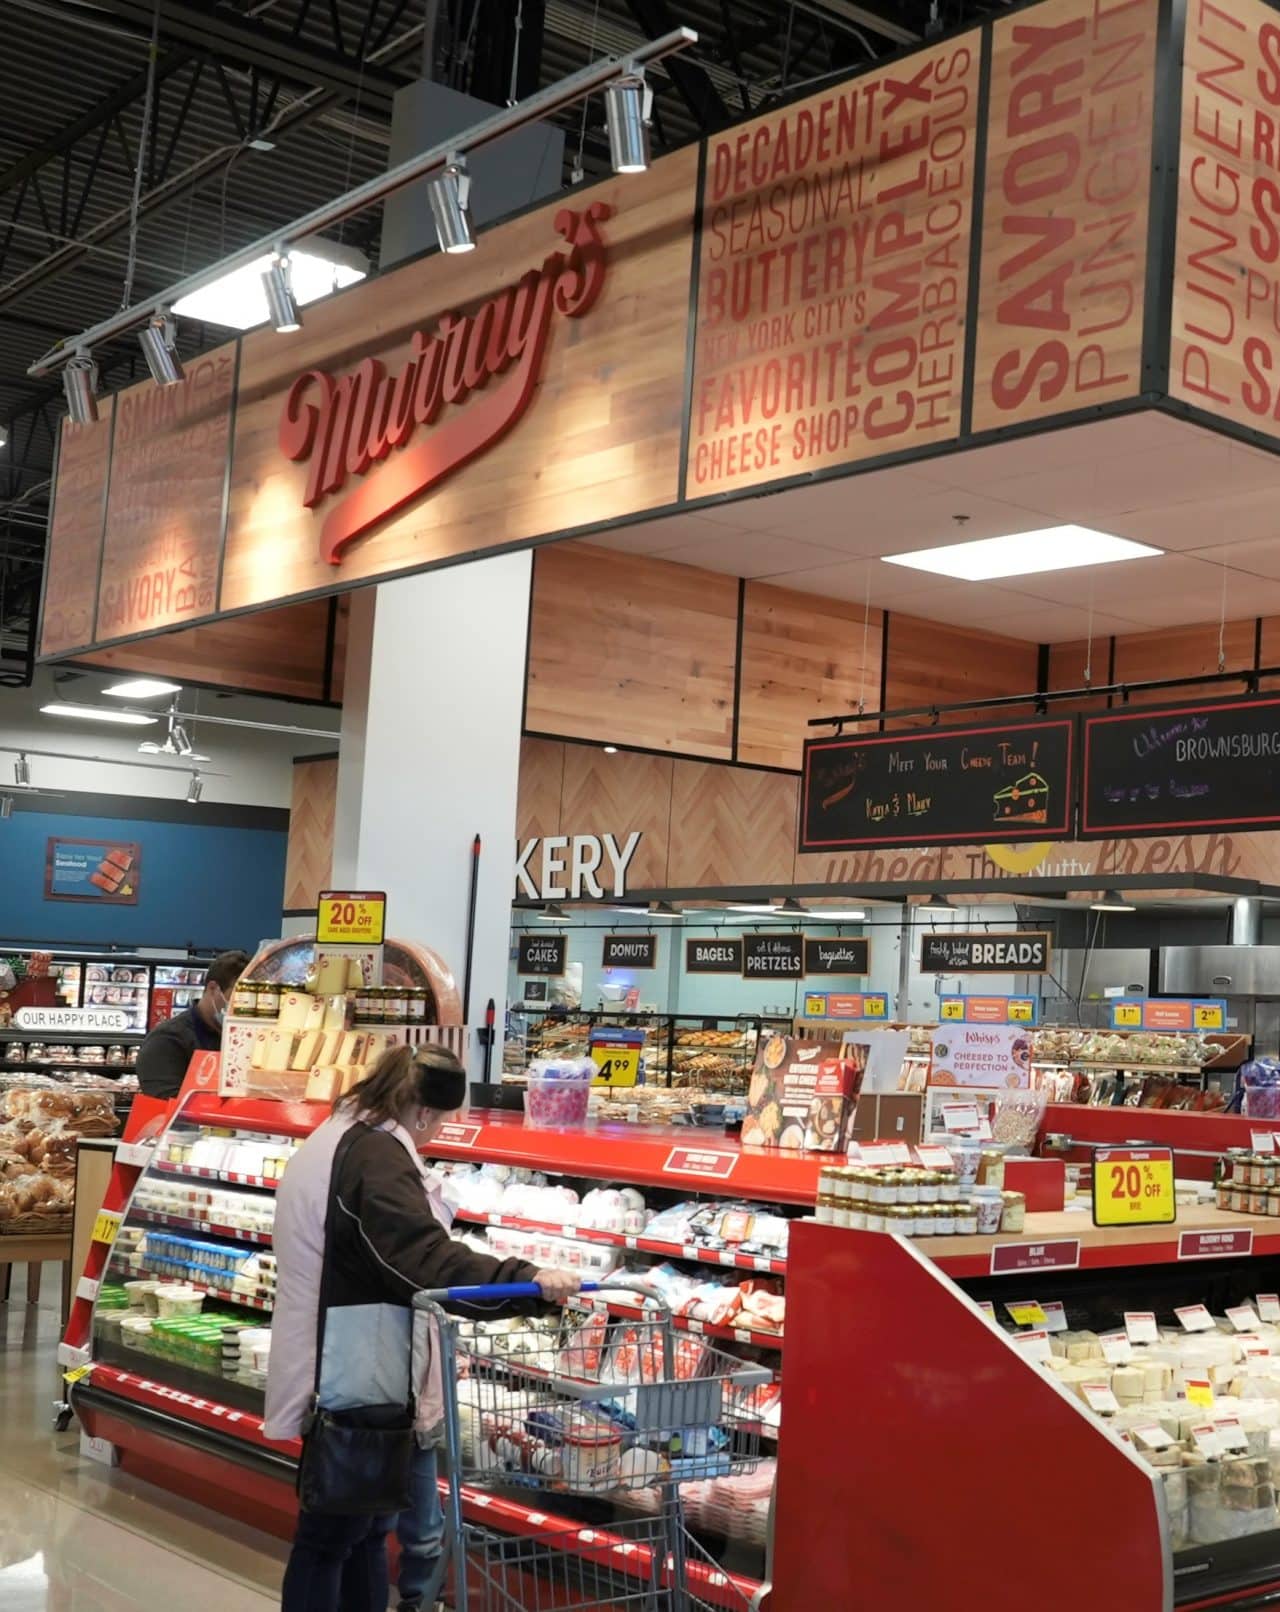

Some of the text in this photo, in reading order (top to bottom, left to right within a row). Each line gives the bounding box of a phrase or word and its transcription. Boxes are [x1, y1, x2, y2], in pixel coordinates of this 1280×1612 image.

[714, 80, 880, 201] DECADENT
[709, 156, 873, 262] SEASONAL
[991, 16, 1087, 410] SAVORY
[1075, 0, 1157, 392] PUNGENT
[1182, 0, 1247, 405] PUNGENT
[707, 215, 871, 327] BUTTERY
[863, 61, 933, 441] COMPLEX
[916, 47, 971, 430] HERBACEOUS
[748, 317, 795, 354] YORK
[803, 292, 867, 343] CITY'S
[279, 203, 610, 565] Murray's
[699, 335, 864, 436] FAVORITE
[694, 405, 859, 484] CHEESE SHOP
[101, 568, 176, 629] SAVORY
[1176, 732, 1280, 762] BROWNSBURG
[527, 949, 558, 962] CAKES
[610, 944, 649, 958] DONUTS
[696, 947, 735, 961] BAGELS
[747, 956, 801, 971] PRETZELS
[971, 943, 1042, 965] BREADS
[23, 1012, 122, 1028] OUR HAPPY PLACE
[954, 1062, 1009, 1072] PERFECTION
[996, 1054, 1009, 1062] TO
